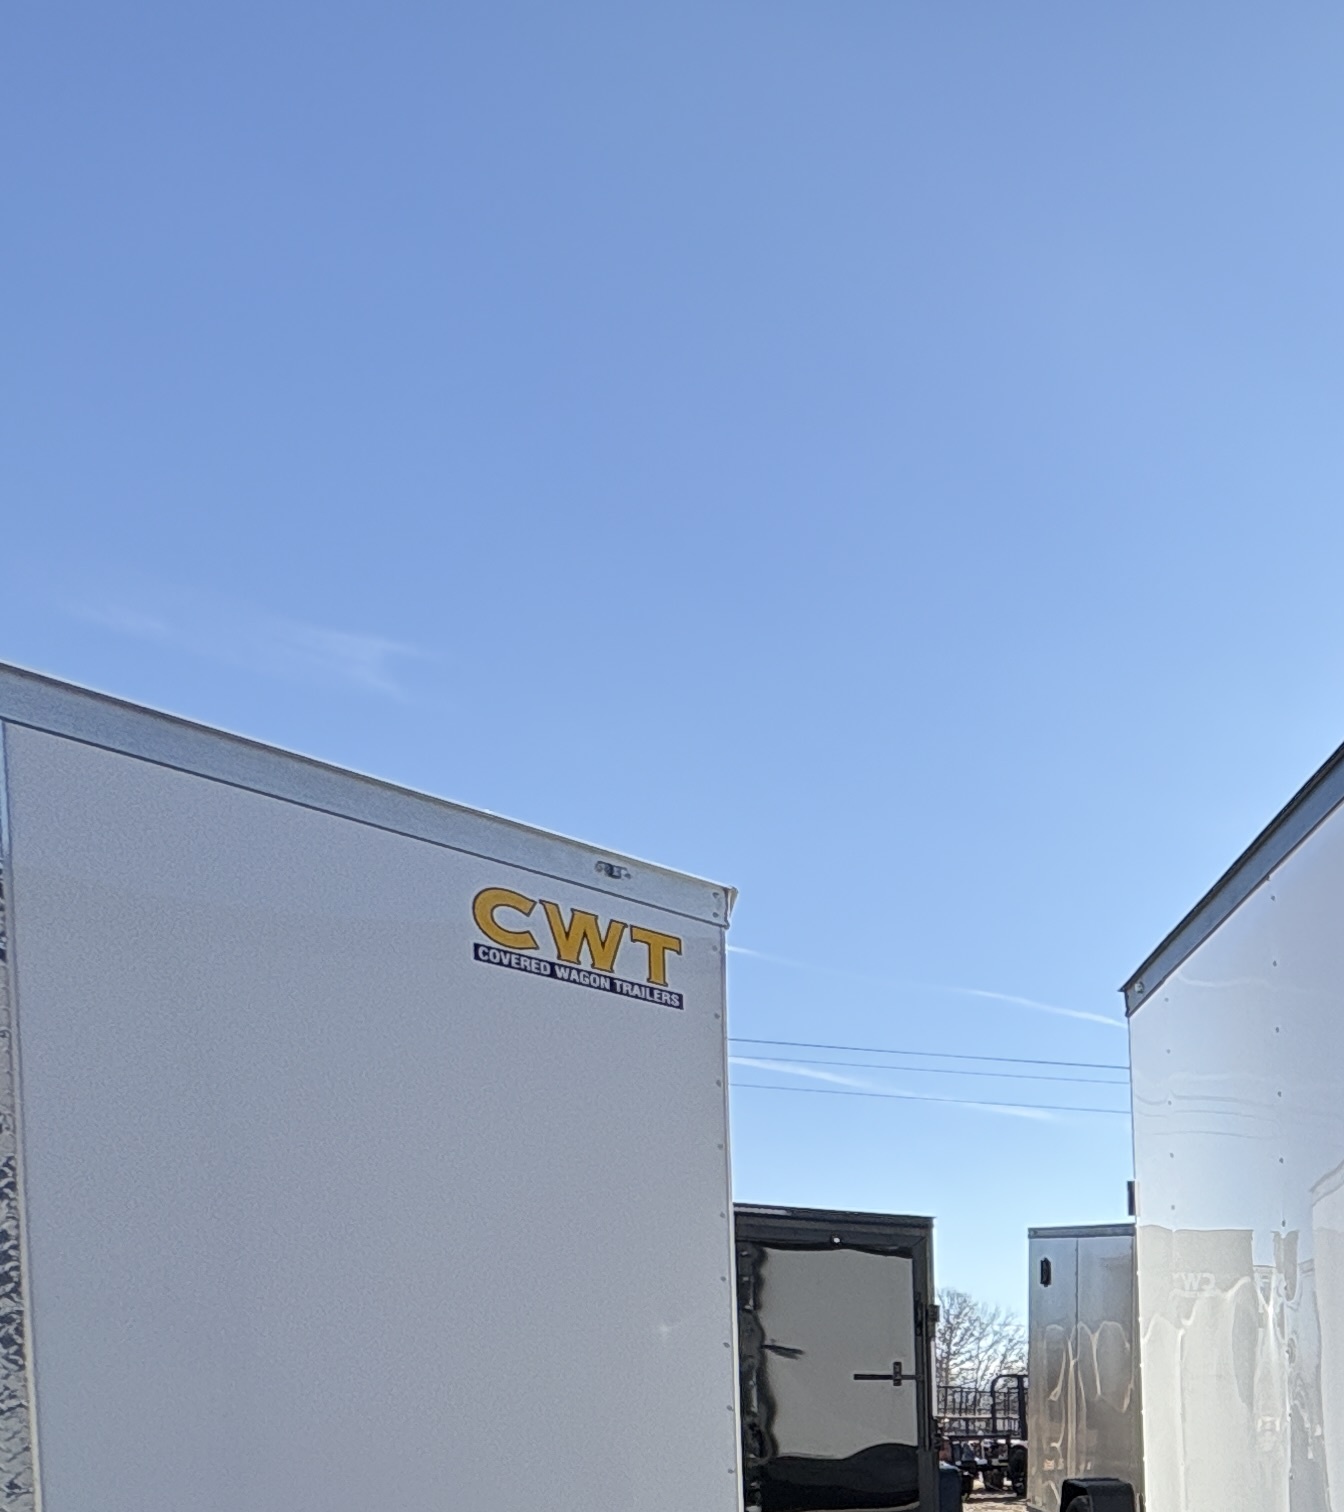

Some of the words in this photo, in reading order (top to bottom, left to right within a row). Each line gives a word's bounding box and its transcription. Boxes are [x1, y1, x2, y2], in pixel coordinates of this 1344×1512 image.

[472, 886, 683, 987] CWT
[478, 946, 551, 975] COVERED
[554, 964, 611, 990] WAGON
[613, 978, 680, 1007] TRAILERS
